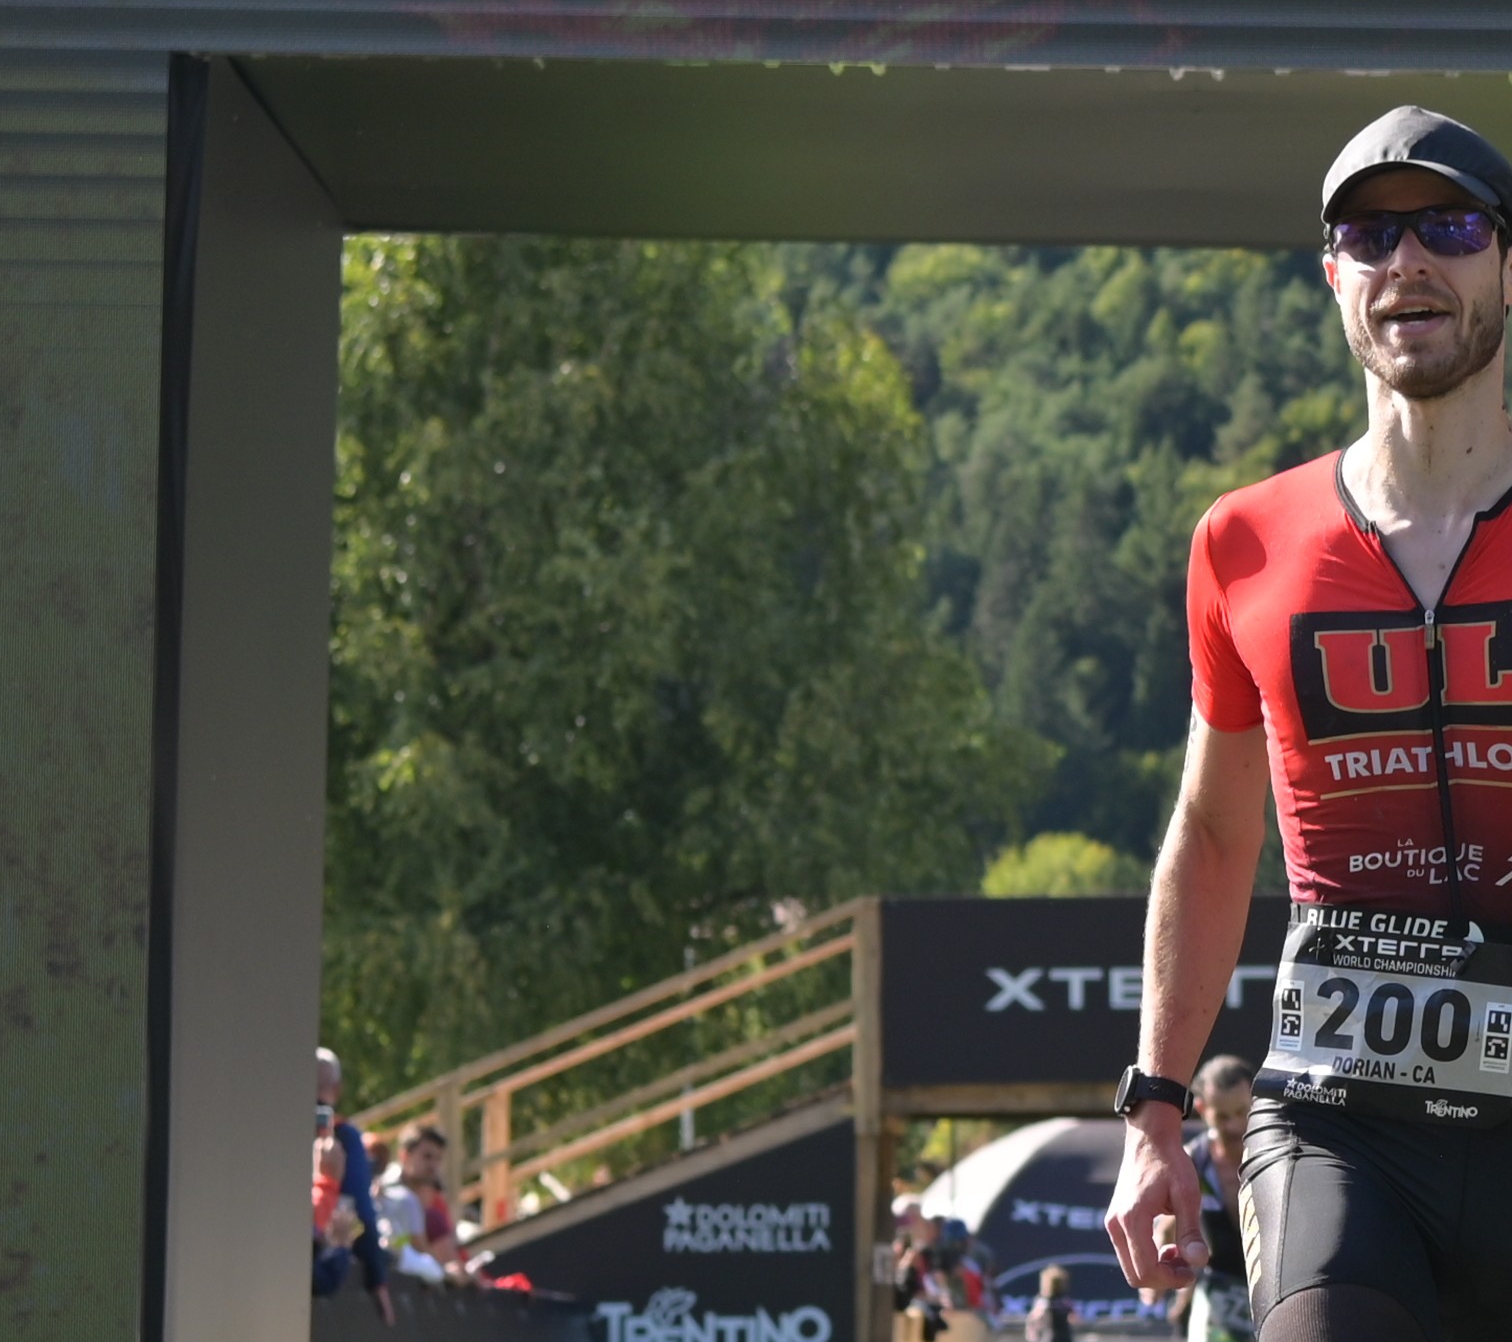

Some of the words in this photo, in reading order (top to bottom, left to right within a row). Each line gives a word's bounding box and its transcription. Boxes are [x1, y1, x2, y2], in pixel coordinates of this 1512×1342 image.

[1397, 838, 1414, 847] LA
[1349, 843, 1483, 873] BOUTIQUE
[1407, 868, 1424, 878] DU
[1307, 909, 1363, 930] BLUE
[1370, 913, 1448, 939] GLIDE
[1333, 954, 1371, 969] WORLD
[1374, 958, 1457, 978] CHAMPIONSHI
[1314, 977, 1471, 1062] 200
[1332, 1056, 1396, 1081] DORIAN
[1412, 1065, 1436, 1084] CA
[1425, 1100, 1478, 1119] TRENTINO
[690, 1204, 830, 1228] DOLOMITI
[663, 1227, 831, 1252] PAGANELLA
